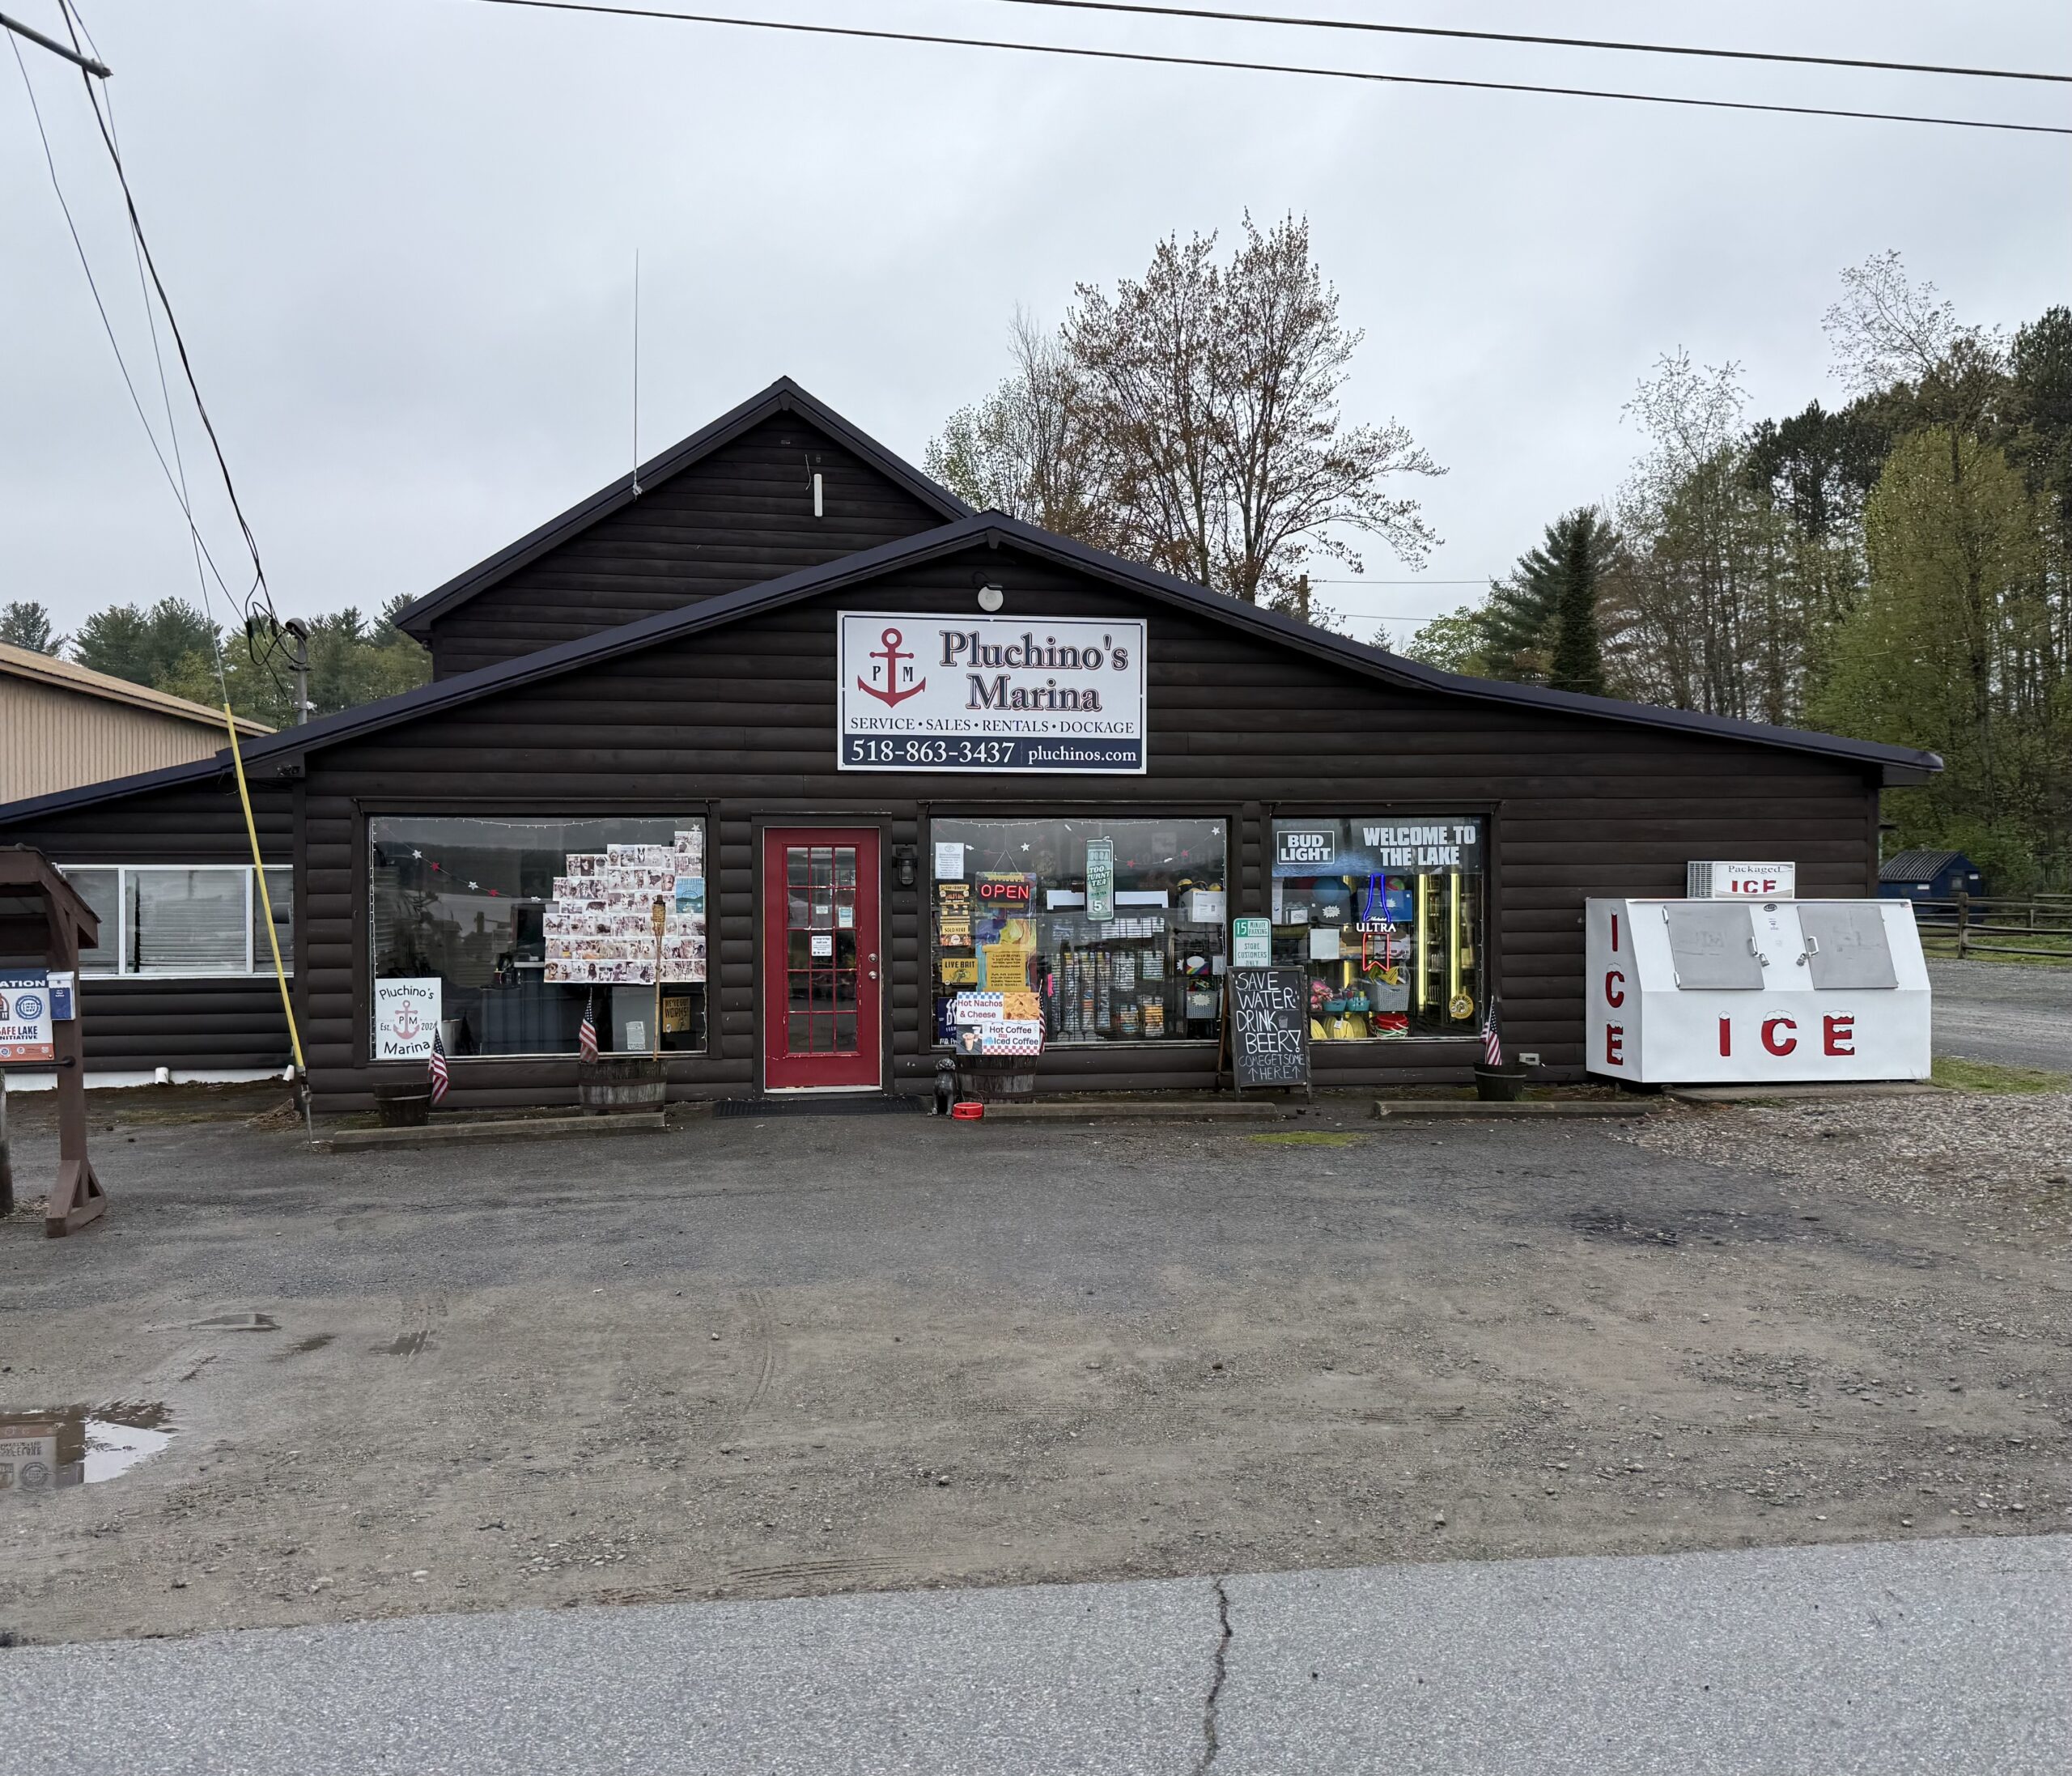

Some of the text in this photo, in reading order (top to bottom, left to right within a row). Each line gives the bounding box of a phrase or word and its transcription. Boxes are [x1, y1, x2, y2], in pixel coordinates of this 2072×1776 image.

[939, 630, 1129, 671] Pluchino's
[872, 665, 914, 682] P M
[965, 673, 1103, 712] Marina
[851, 717, 1135, 734] SERVICE SALES RENTALS DOCKAGE
[851, 738, 1137, 765] 518-863-3437 pluchinos.com
[1287, 835, 1324, 848] BUD
[1362, 826, 1476, 847] WELCOME TO
[1280, 848, 1331, 861] LIGHT
[1379, 847, 1460, 867] THE LAKE
[1087, 870, 1111, 881] TURNT
[1089, 865, 1105, 874] TOO
[1728, 865, 1781, 874] Packaged
[1091, 878, 1106, 887] TEA
[980, 884, 1029, 899] OPEN
[1236, 922, 1247, 935] 15
[1356, 922, 1397, 933] ULTRA
[945, 961, 959, 969] LIVE
[1236, 971, 1280, 992] SAVE
[1605, 906, 1625, 1066] ICE
[379, 984, 435, 1001] Pluchino's
[1237, 987, 1297, 1010] WATER
[399, 1016, 418, 1025] P M
[967, 1010, 996, 1018] Cheese
[1236, 1009, 1279, 1032] DRINK
[18, 1026, 38, 1035] LAKE
[380, 1022, 392, 1031] Est.
[989, 1026, 1032, 1034] Hot Coffee
[1718, 1010, 1856, 1057] ICE
[384, 1041, 431, 1055] Marina
[994, 1037, 1039, 1045] Iced Coffee
[1246, 1029, 1301, 1054] BEER!
[1259, 1064, 1293, 1081] HERE
